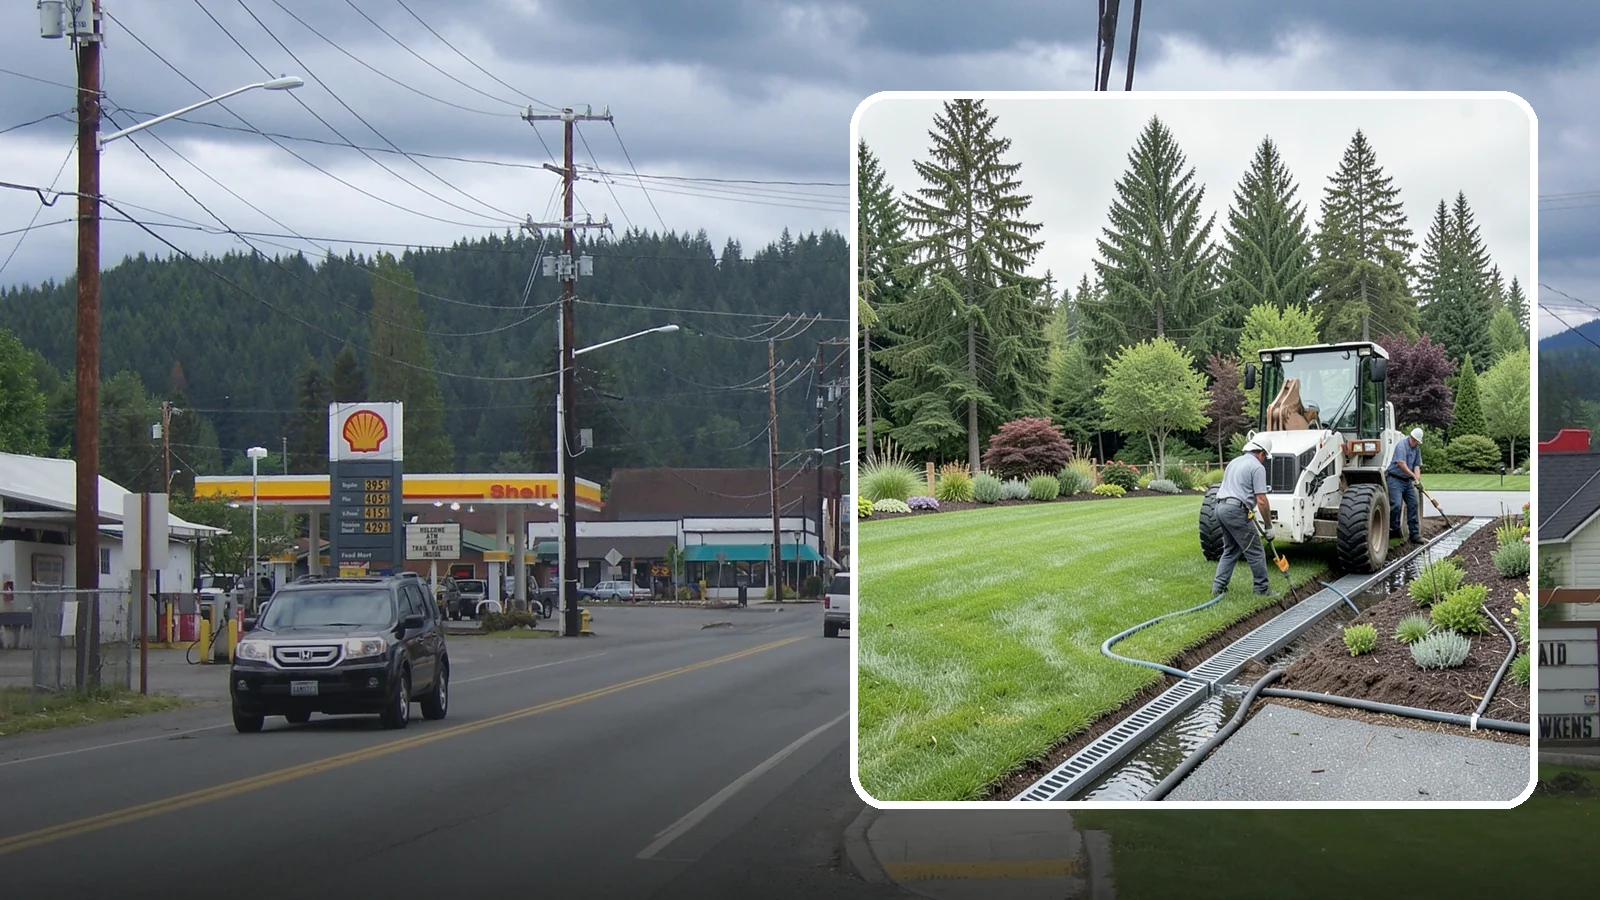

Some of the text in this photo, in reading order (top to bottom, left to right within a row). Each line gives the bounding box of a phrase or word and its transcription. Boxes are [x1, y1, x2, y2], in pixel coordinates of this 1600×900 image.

[366, 480, 383, 490] 395
[490, 484, 547, 499] Shell
[365, 494, 383, 504] 405
[365, 508, 383, 518] 415
[366, 522, 383, 532] 429
[1538, 643, 1566, 666] AID
